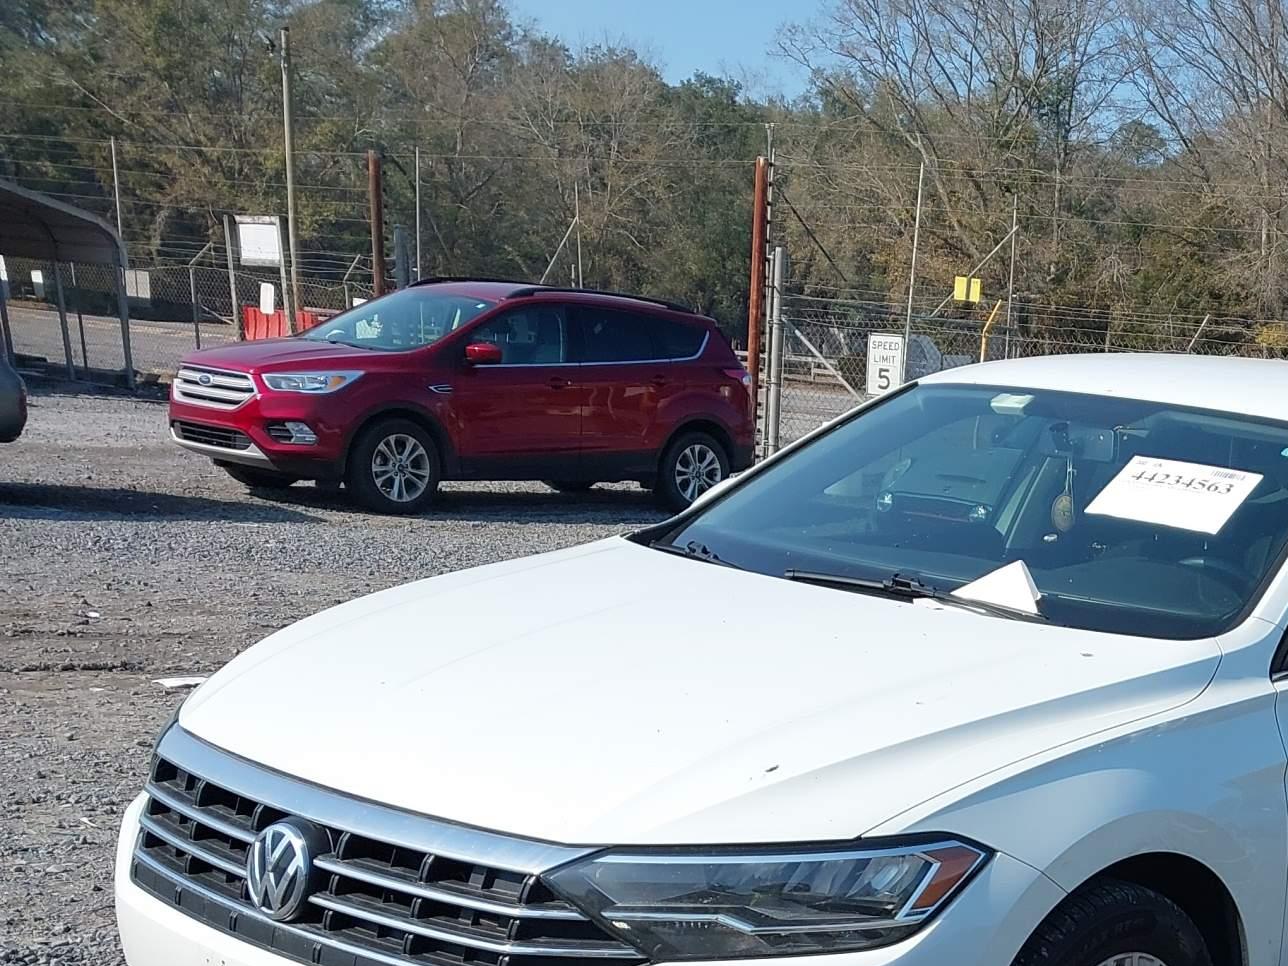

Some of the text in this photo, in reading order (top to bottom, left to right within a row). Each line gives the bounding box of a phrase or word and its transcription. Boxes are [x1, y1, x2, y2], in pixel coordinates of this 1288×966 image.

[872, 340, 900, 351] SPEED
[873, 353, 897, 365] LIMIT
[877, 368, 890, 390] 5
[1131, 470, 1235, 495] 44234563
